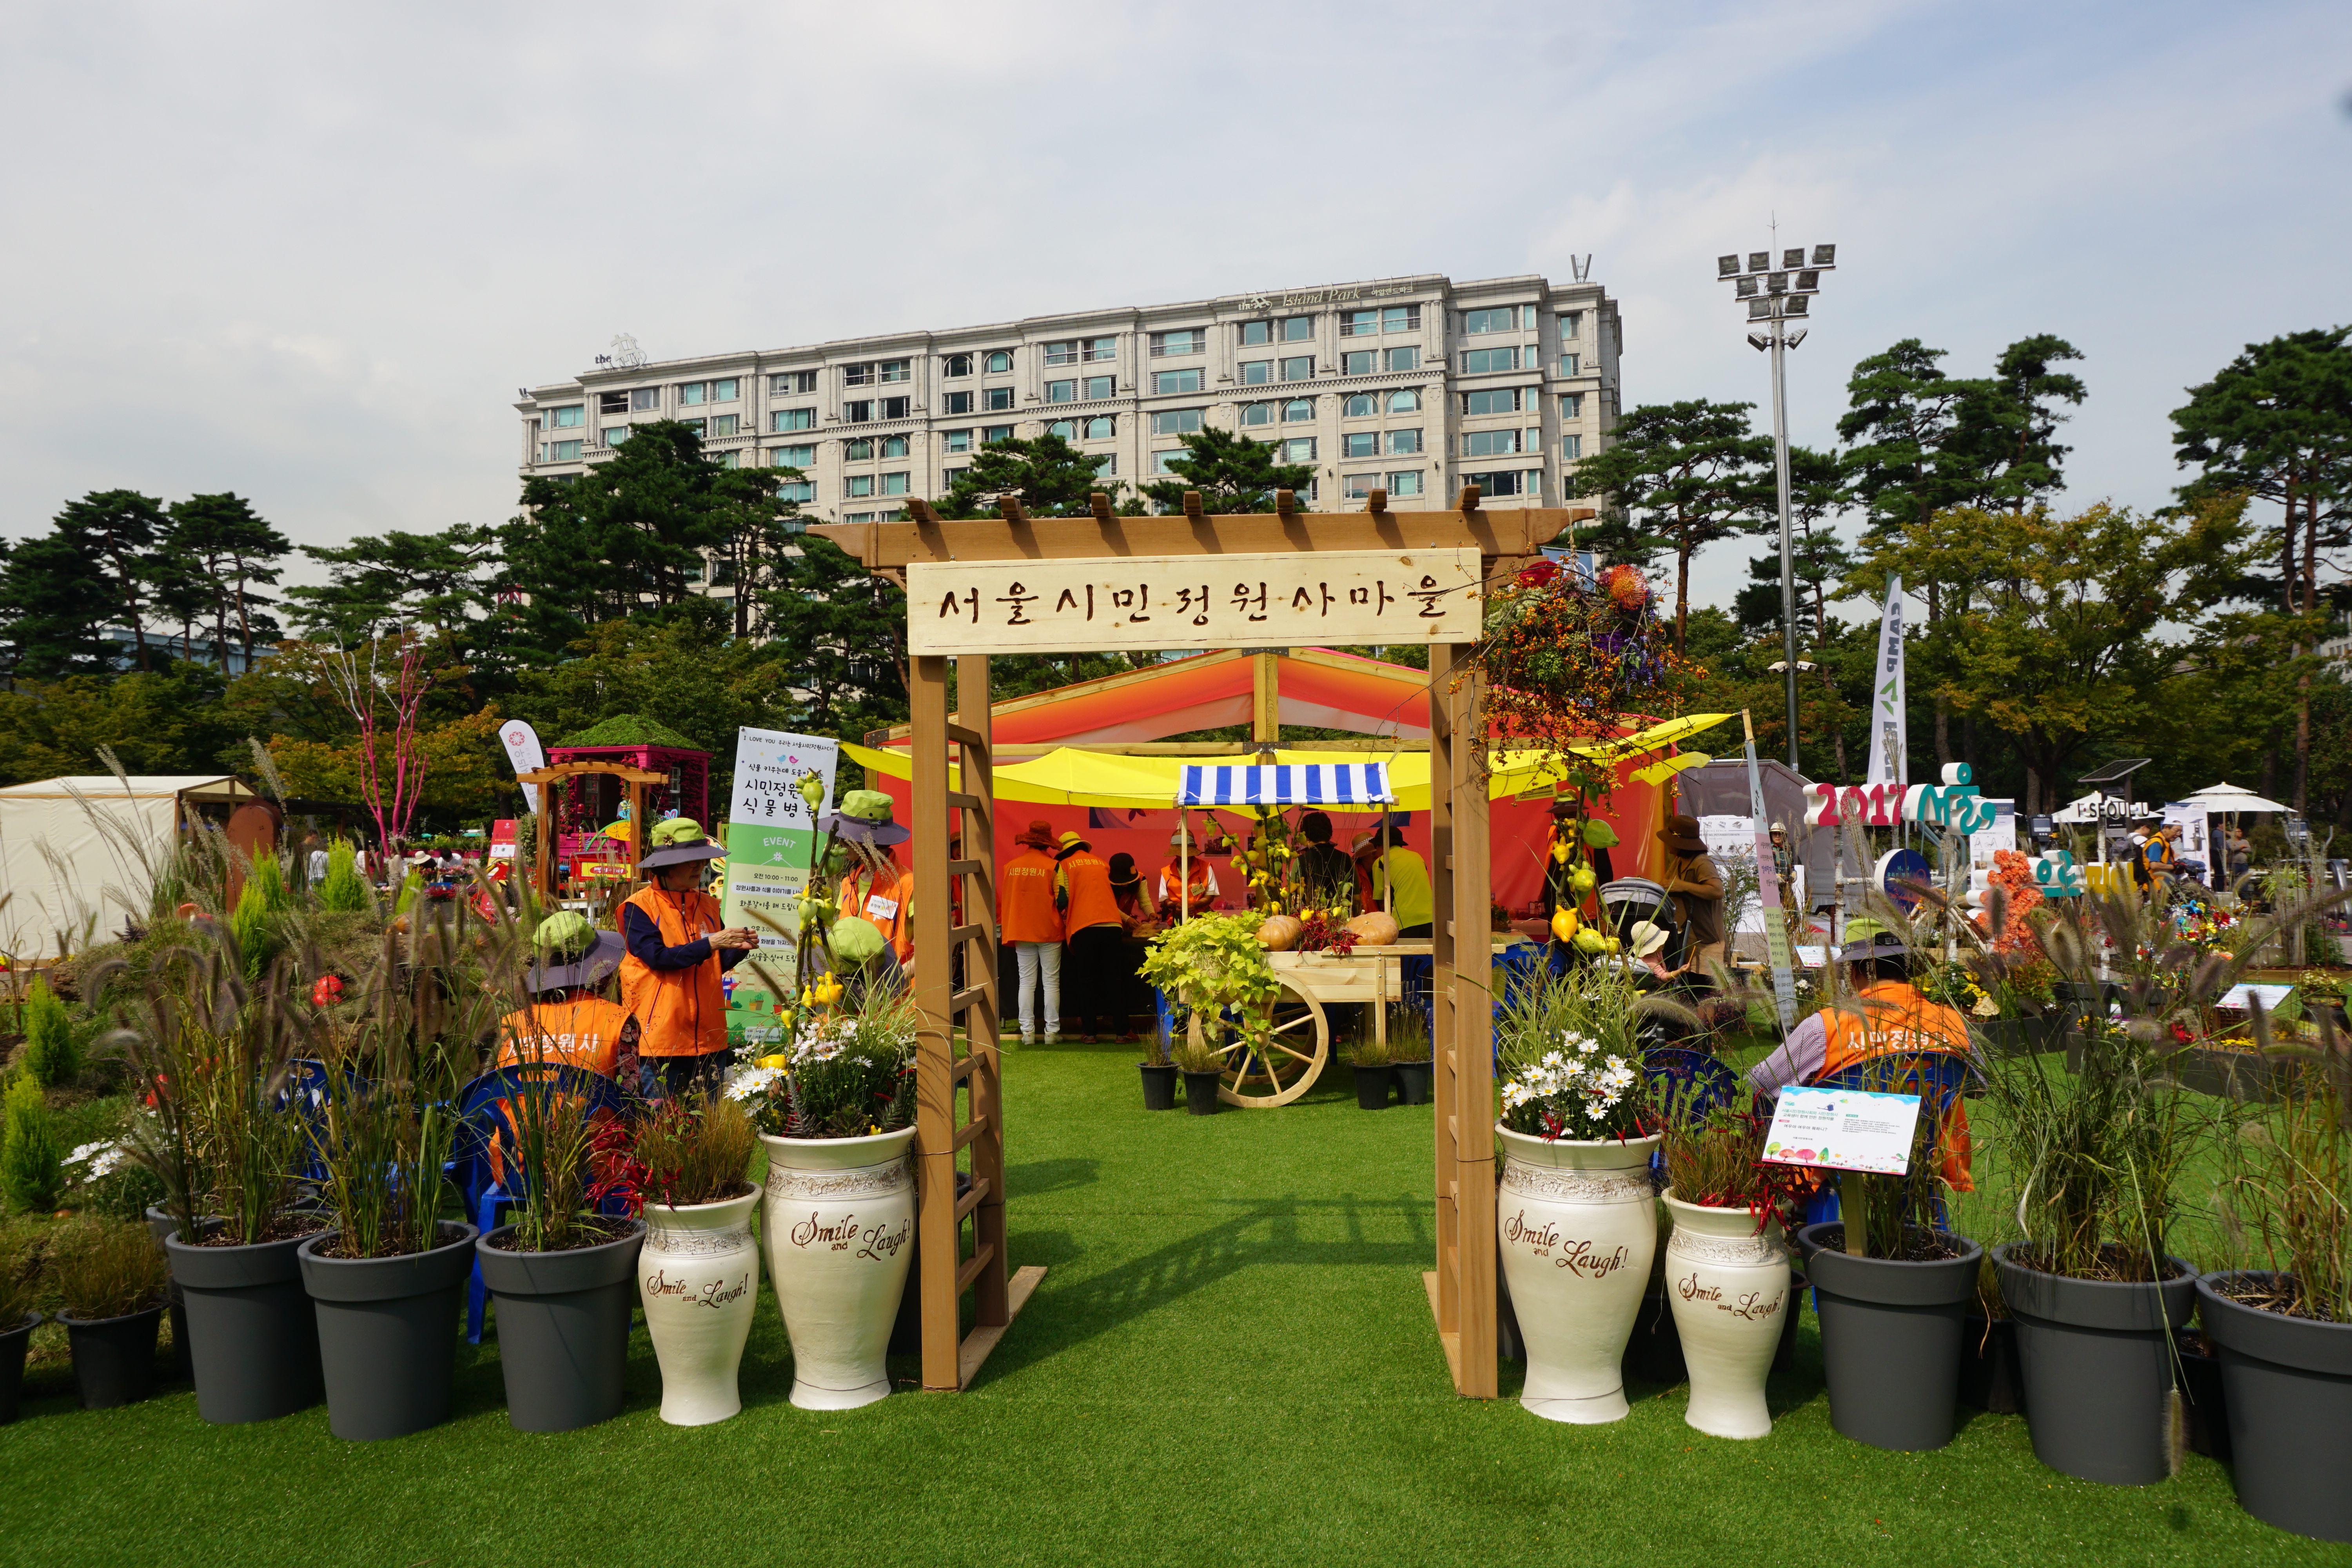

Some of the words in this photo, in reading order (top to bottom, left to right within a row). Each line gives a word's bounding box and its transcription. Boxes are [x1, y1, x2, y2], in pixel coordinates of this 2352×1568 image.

[1281, 290, 1323, 307] Island
[1327, 286, 1361, 303] Park
[1371, 286, 1414, 297] 아일랜드파크
[748, 763, 761, 772] 식물
[764, 766, 789, 775] 키우는데
[791, 769, 809, 777] 도움이
[745, 779, 799, 799] 시민정원
[1815, 783, 1907, 826] 2017
[763, 837, 796, 848] EVENT
[1009, 867, 1045, 877] 시민정원사
[1069, 858, 1105, 869] 시민정원사
[739, 900, 770, 910] 화분갈이를
[791, 1211, 858, 1249] Smile
[831, 1241, 848, 1251] and
[857, 1219, 910, 1261] Laugh!
[1504, 1209, 1559, 1247] Smile
[1533, 1248, 1549, 1257] and
[1555, 1240, 1628, 1279] Laugh!
[646, 1269, 686, 1298] Smile
[682, 1294, 697, 1303] and
[699, 1273, 748, 1308] Laugh!
[1678, 1272, 1722, 1301] Smile
[1717, 1303, 1732, 1312] and
[1733, 1290, 1784, 1321] Laugh!
